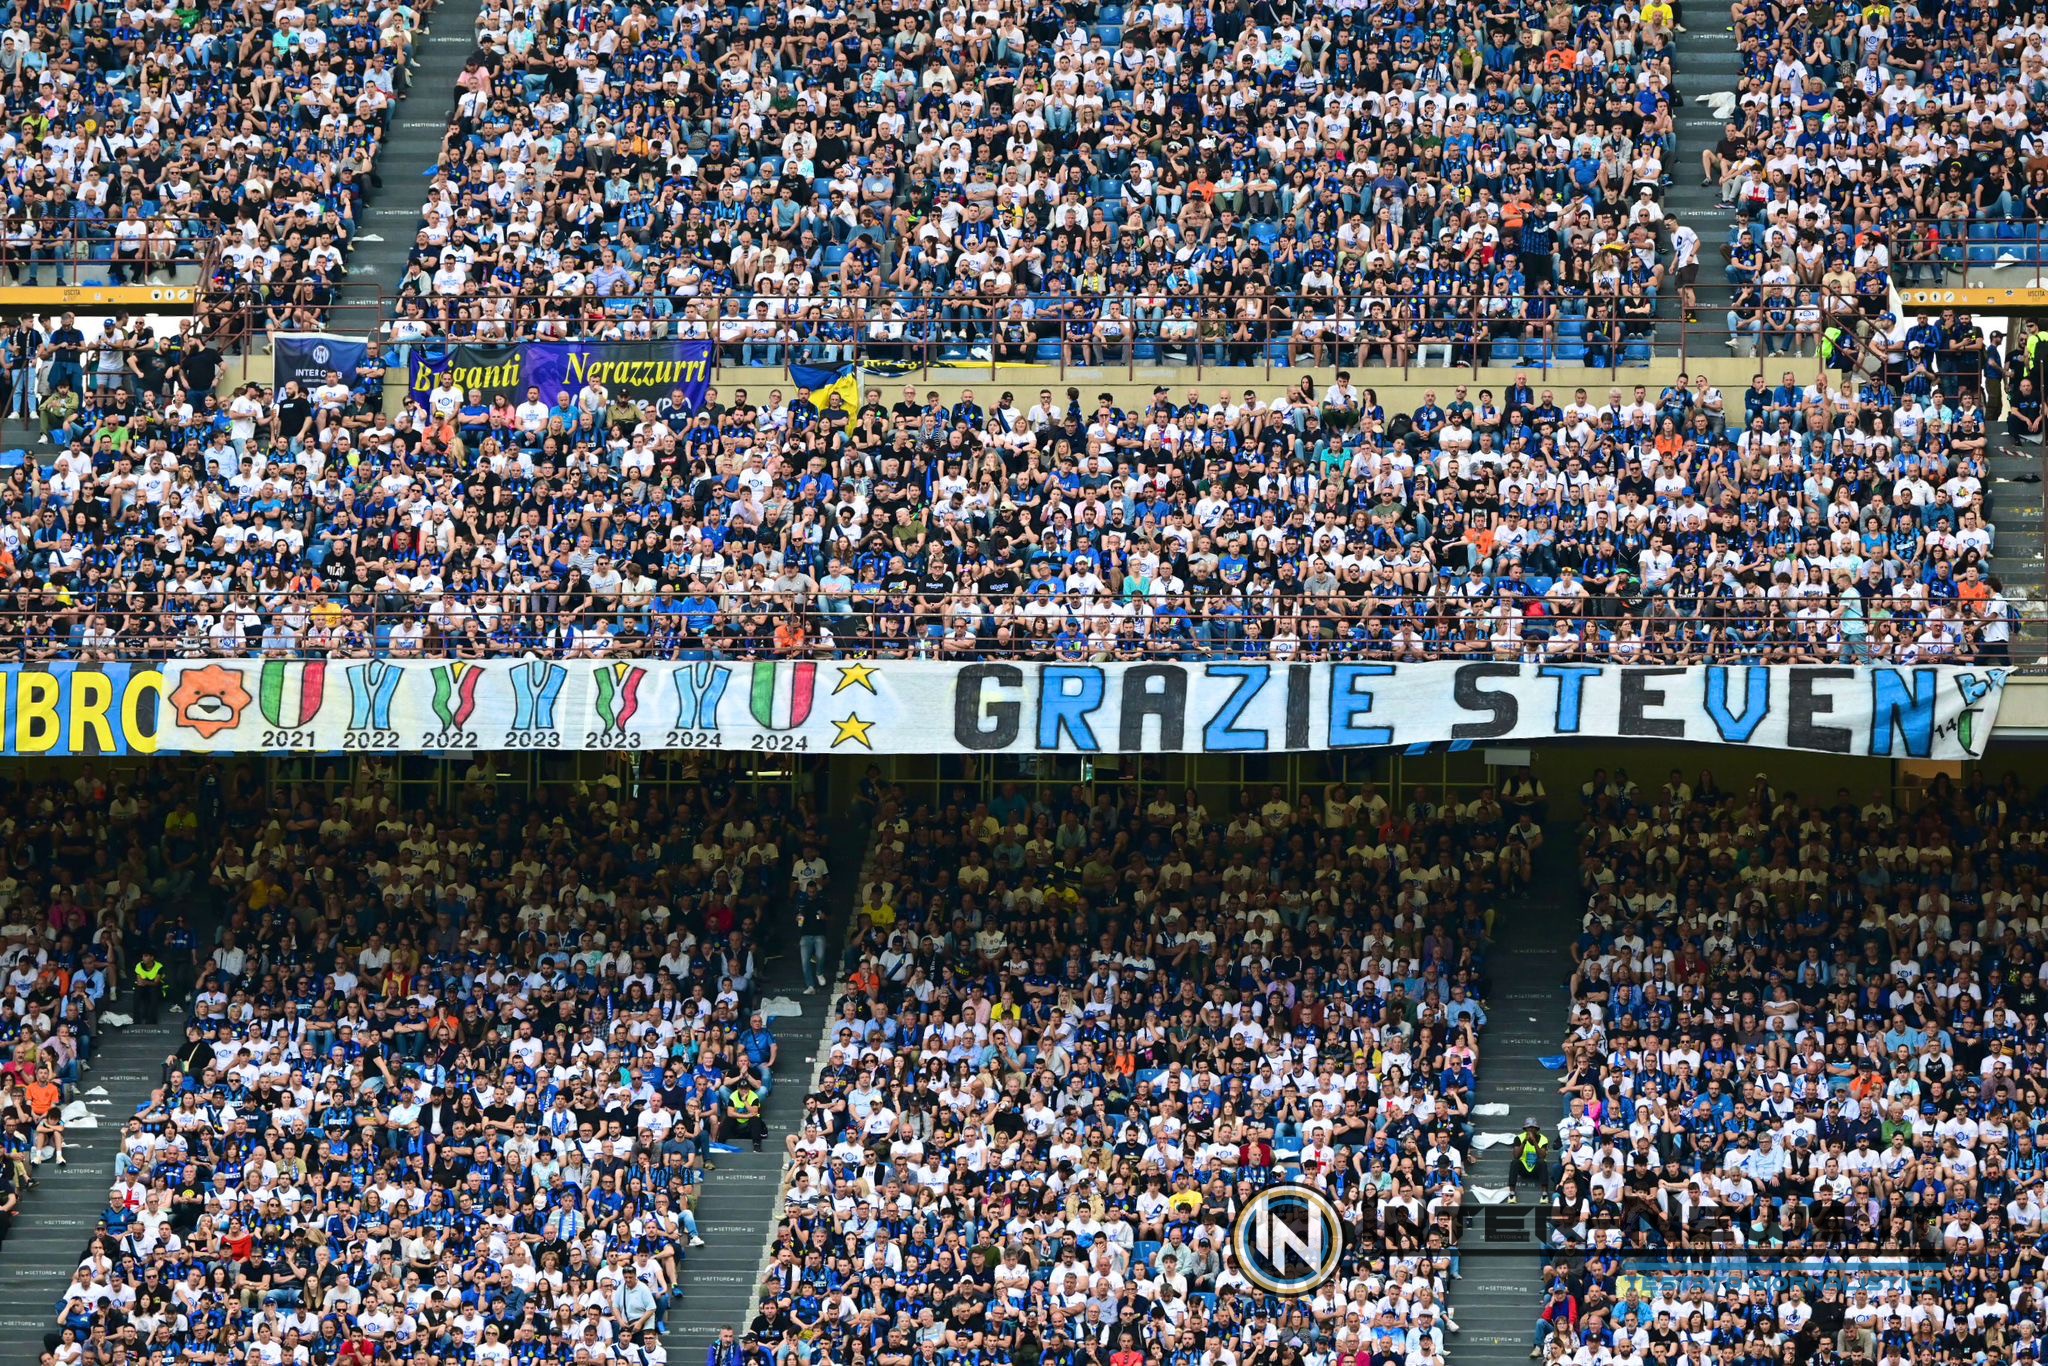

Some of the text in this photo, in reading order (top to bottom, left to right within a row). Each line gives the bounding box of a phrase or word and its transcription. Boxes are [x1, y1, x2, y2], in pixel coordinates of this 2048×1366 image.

[295, 368, 343, 379] INTER CB
[413, 350, 709, 394] Brganti Nerazzurri
[954, 663, 1396, 751] GRAZIE
[1451, 663, 1937, 758] STEVEN
[261, 731, 808, 751] 2021 2022 2022 2023 2023 2024 2024
